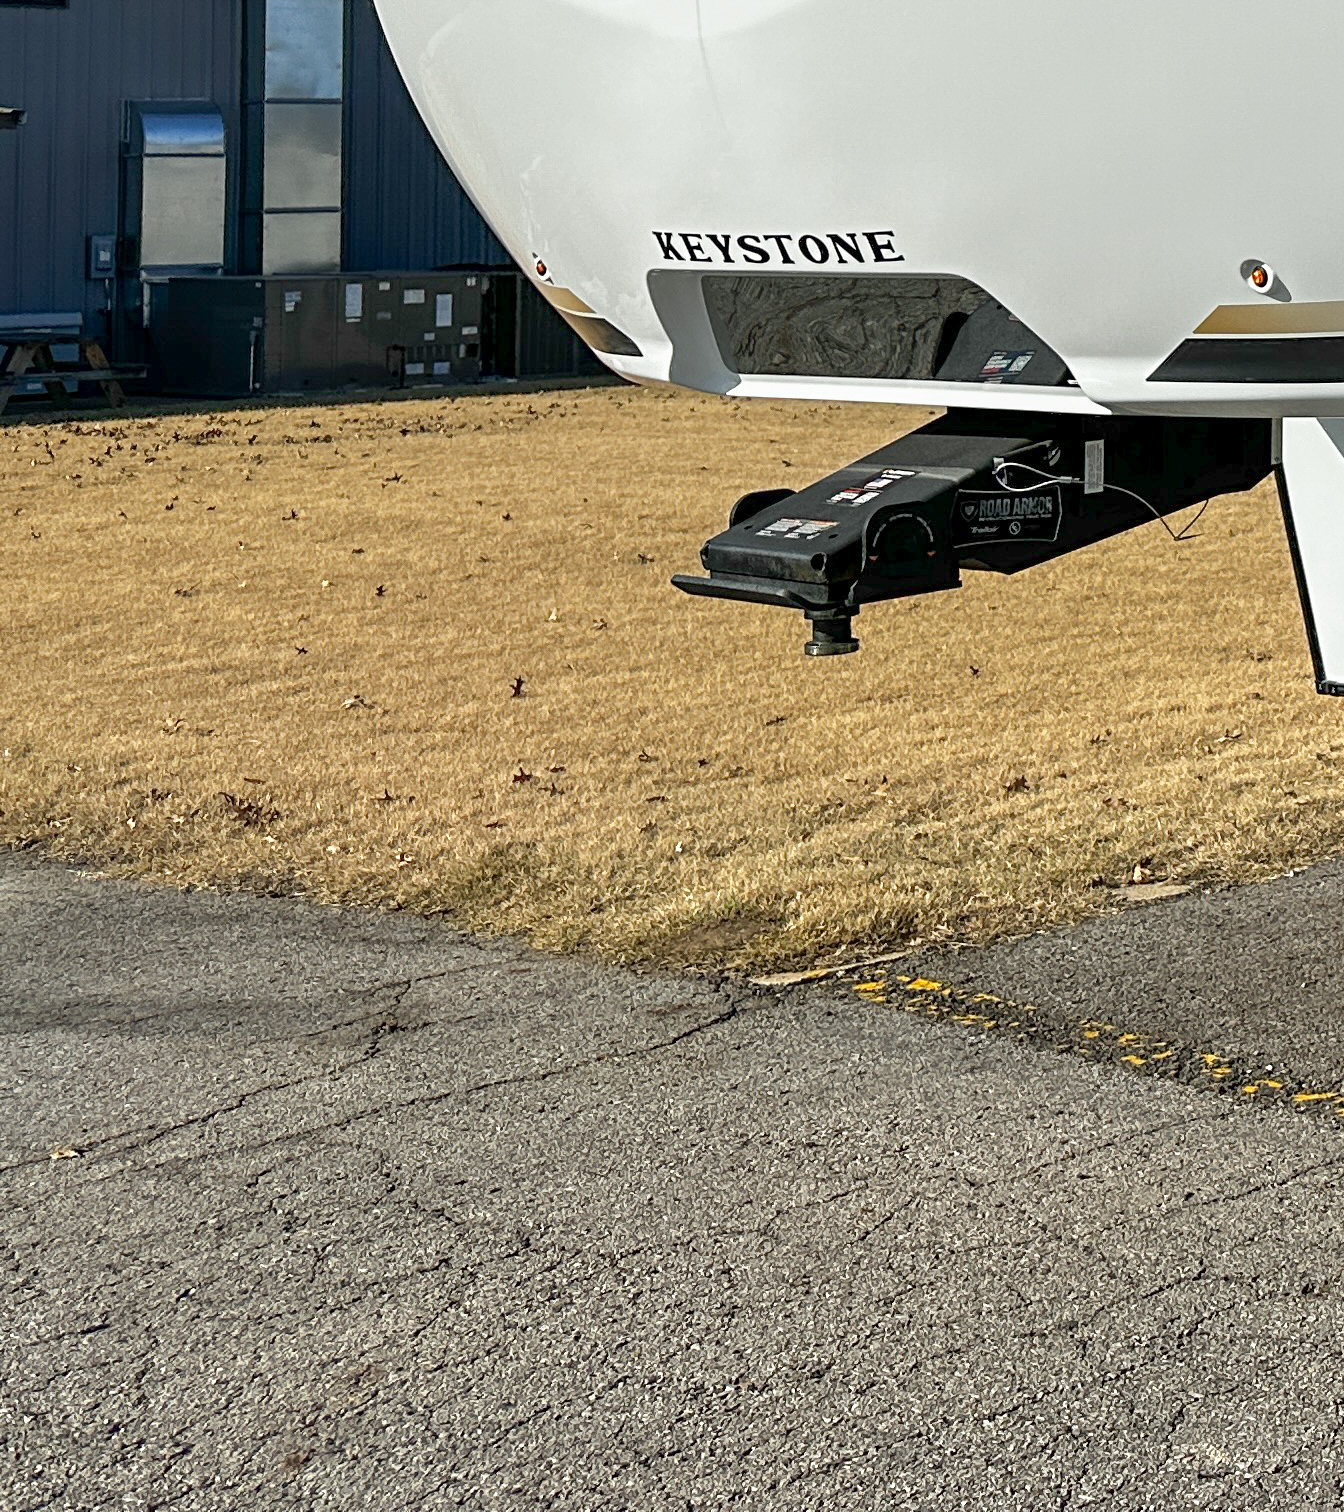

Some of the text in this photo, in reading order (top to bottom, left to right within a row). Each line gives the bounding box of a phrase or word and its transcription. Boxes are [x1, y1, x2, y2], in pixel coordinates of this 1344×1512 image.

[651, 230, 906, 265] KEYSTONE
[979, 496, 1053, 517] ROAD ARMOR
